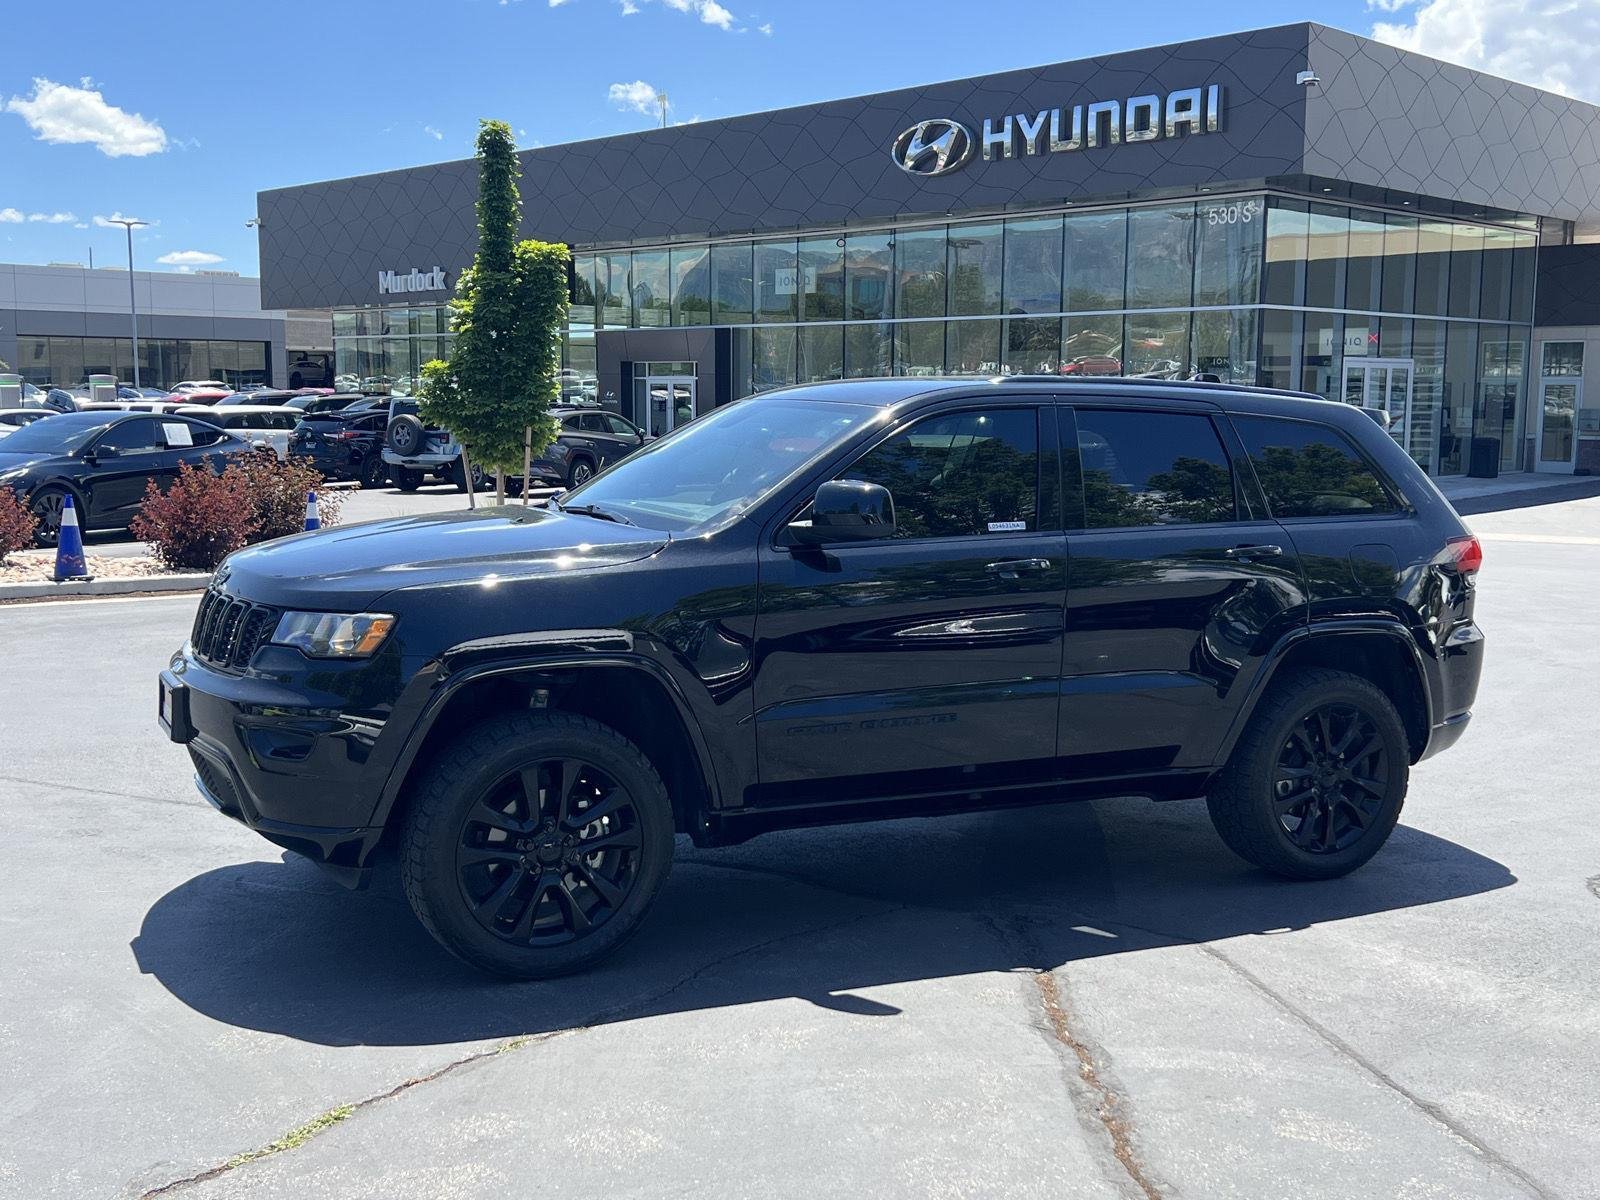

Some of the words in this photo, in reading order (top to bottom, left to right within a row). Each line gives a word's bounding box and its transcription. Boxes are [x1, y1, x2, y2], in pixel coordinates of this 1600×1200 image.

[983, 84, 1220, 160] HYUNDAI
[1208, 206, 1237, 225] 530
[379, 266, 447, 294] Murdock
